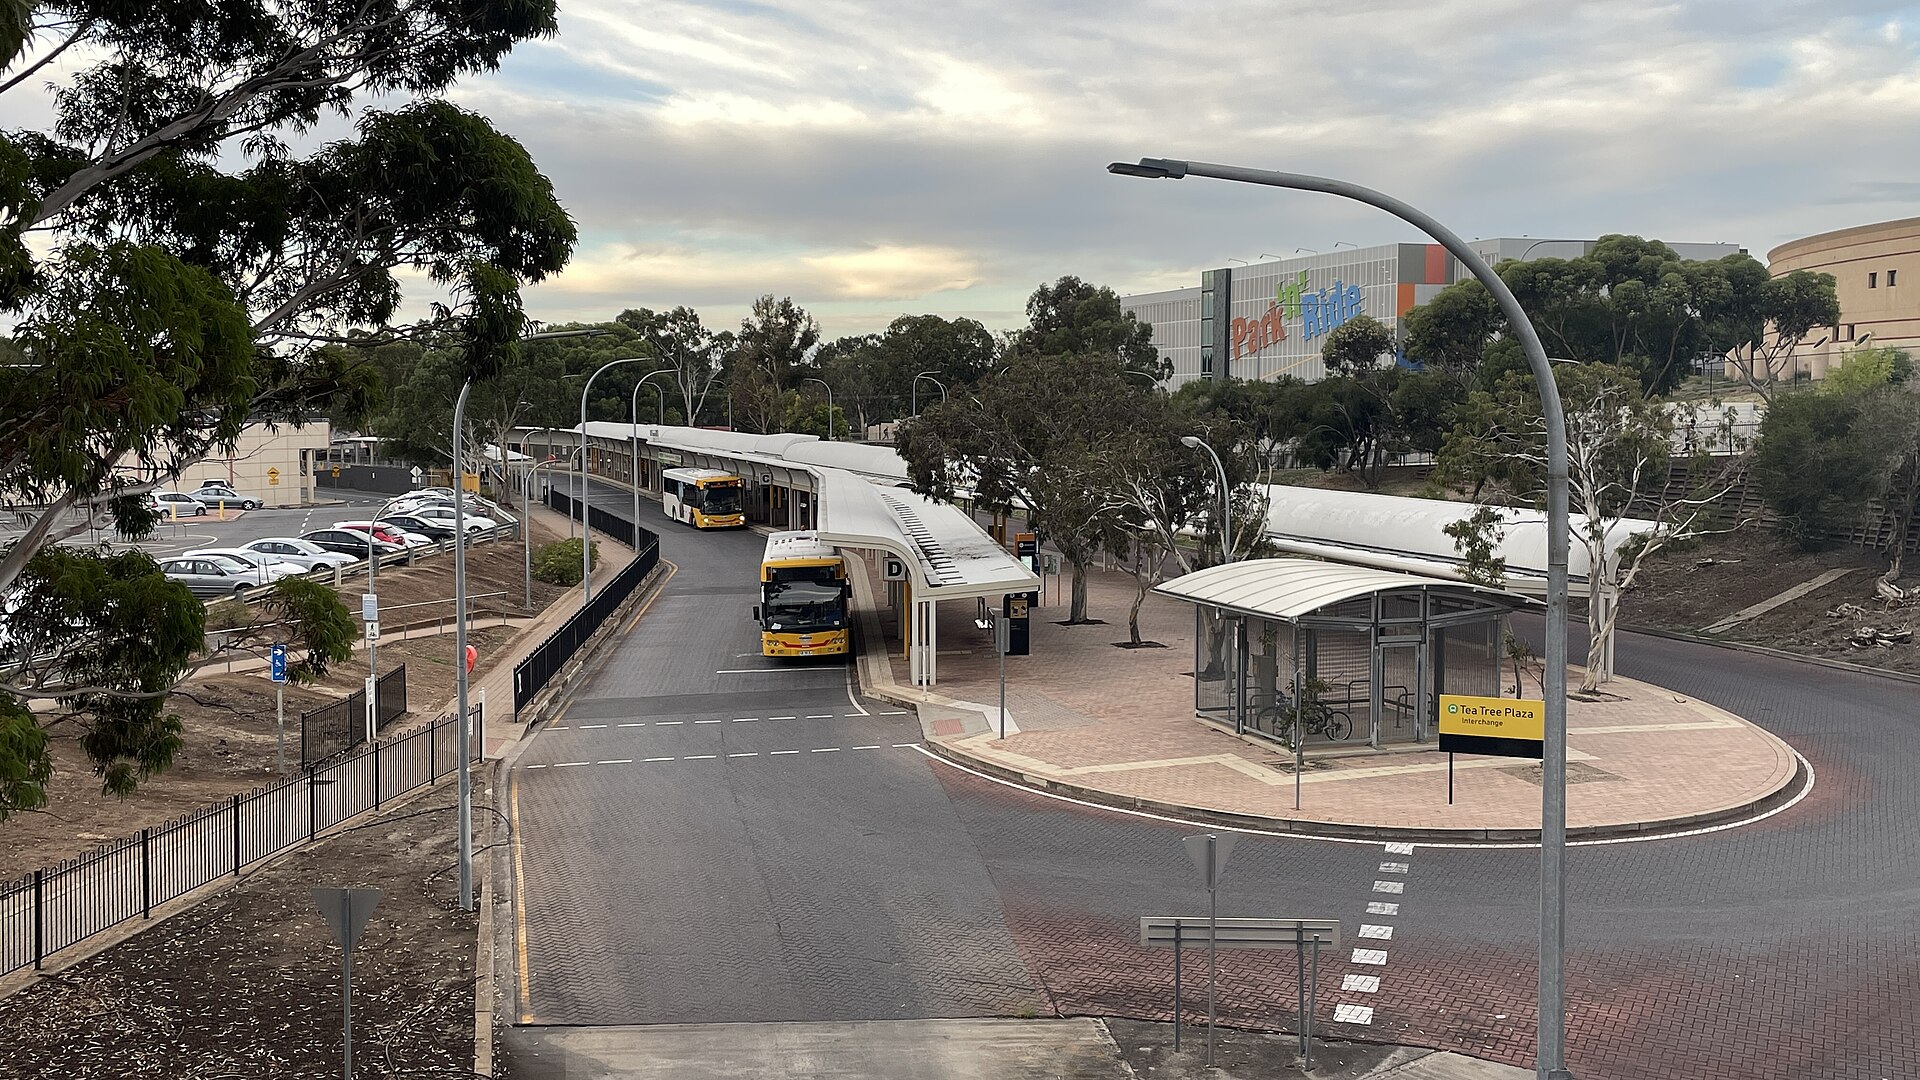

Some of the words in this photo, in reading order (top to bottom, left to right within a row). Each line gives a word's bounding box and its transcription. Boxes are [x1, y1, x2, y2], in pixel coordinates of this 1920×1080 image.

[1231, 300, 1287, 360] Park
[1301, 280, 1361, 342] Ride
[887, 561, 903, 577] D
[1460, 704, 1478, 715] Tea
[1479, 706, 1502, 717] Tree
[1504, 707, 1534, 719] Plaza
[1461, 717, 1504, 727] Interchange
